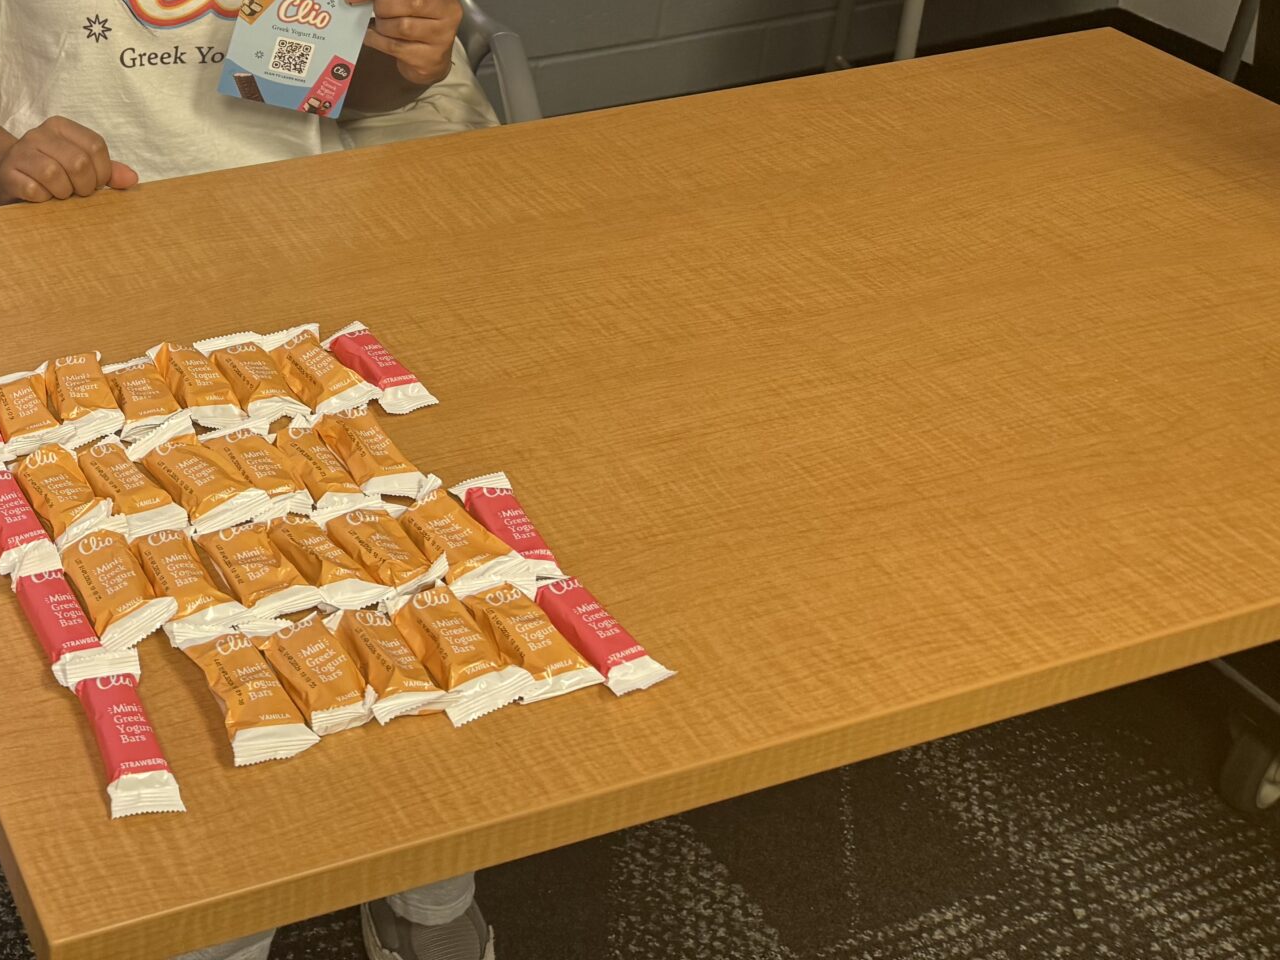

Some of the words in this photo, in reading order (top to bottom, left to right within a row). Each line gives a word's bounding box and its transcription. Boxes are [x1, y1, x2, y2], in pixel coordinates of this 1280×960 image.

[272, 24, 289, 33] Greek
[119, 46, 187, 69] Greek
[56, 356, 86, 368] Clio
[378, 360, 397, 368] Bars
[192, 371, 220, 380] Yogurt
[316, 364, 334, 376] Bars
[65, 373, 86, 382] Mini
[127, 378, 147, 387] Mini
[328, 378, 351, 392] VANILLA
[26, 447, 58, 469] Clio
[243, 450, 264, 459] Mini
[179, 456, 199, 469] Mini
[44, 474, 65, 484] Mini
[255, 470, 276, 479] Bars
[48, 480, 73, 490] Greek
[123, 480, 145, 490] Bars
[195, 475, 216, 487] Bars
[210, 486, 236, 502] VANILLA
[135, 497, 161, 508] VANILLA
[4, 514, 27, 524] Bars
[429, 516, 451, 529] Mini
[435, 524, 461, 535] Greek
[508, 524, 535, 533] Yogu
[439, 528, 473, 542] Yogurt
[513, 531, 537, 540] Bars
[78, 536, 113, 555] Clio
[447, 539, 469, 549] Bars
[165, 553, 188, 563] Mini
[236, 547, 259, 560] Mini
[95, 559, 119, 575] Mini
[167, 562, 195, 572] Greek
[98, 566, 127, 582] Greek
[102, 570, 136, 588] Yogurt
[247, 567, 270, 581] Bars
[175, 575, 199, 587] Bars
[106, 580, 129, 595] Bars
[49, 593, 72, 603] Mini
[413, 590, 450, 610] Clio
[485, 588, 522, 606] Clio
[577, 602, 600, 615] Mini
[54, 611, 82, 620] Yogu
[512, 611, 534, 624] Mini
[59, 618, 82, 628] Bars
[436, 618, 459, 629] Mini
[515, 619, 546, 633] Greek
[588, 619, 618, 631] Yogu
[440, 626, 470, 637] Greek
[596, 627, 621, 639] Bars
[216, 634, 252, 655] Clio
[444, 633, 483, 645] Yogurt
[528, 638, 553, 652] Bars
[301, 642, 327, 658] Mini
[451, 644, 476, 655] Bars
[306, 649, 336, 667] Greek
[236, 663, 262, 677] Mini
[311, 655, 348, 675] Yogurt
[544, 660, 574, 674] VANILLA
[320, 670, 344, 684] Bars
[248, 690, 273, 701] Bars
[113, 704, 138, 714] Mini
[114, 713, 146, 724] Greek
[259, 713, 292, 722] VANILLA
[120, 733, 147, 744] Bars
